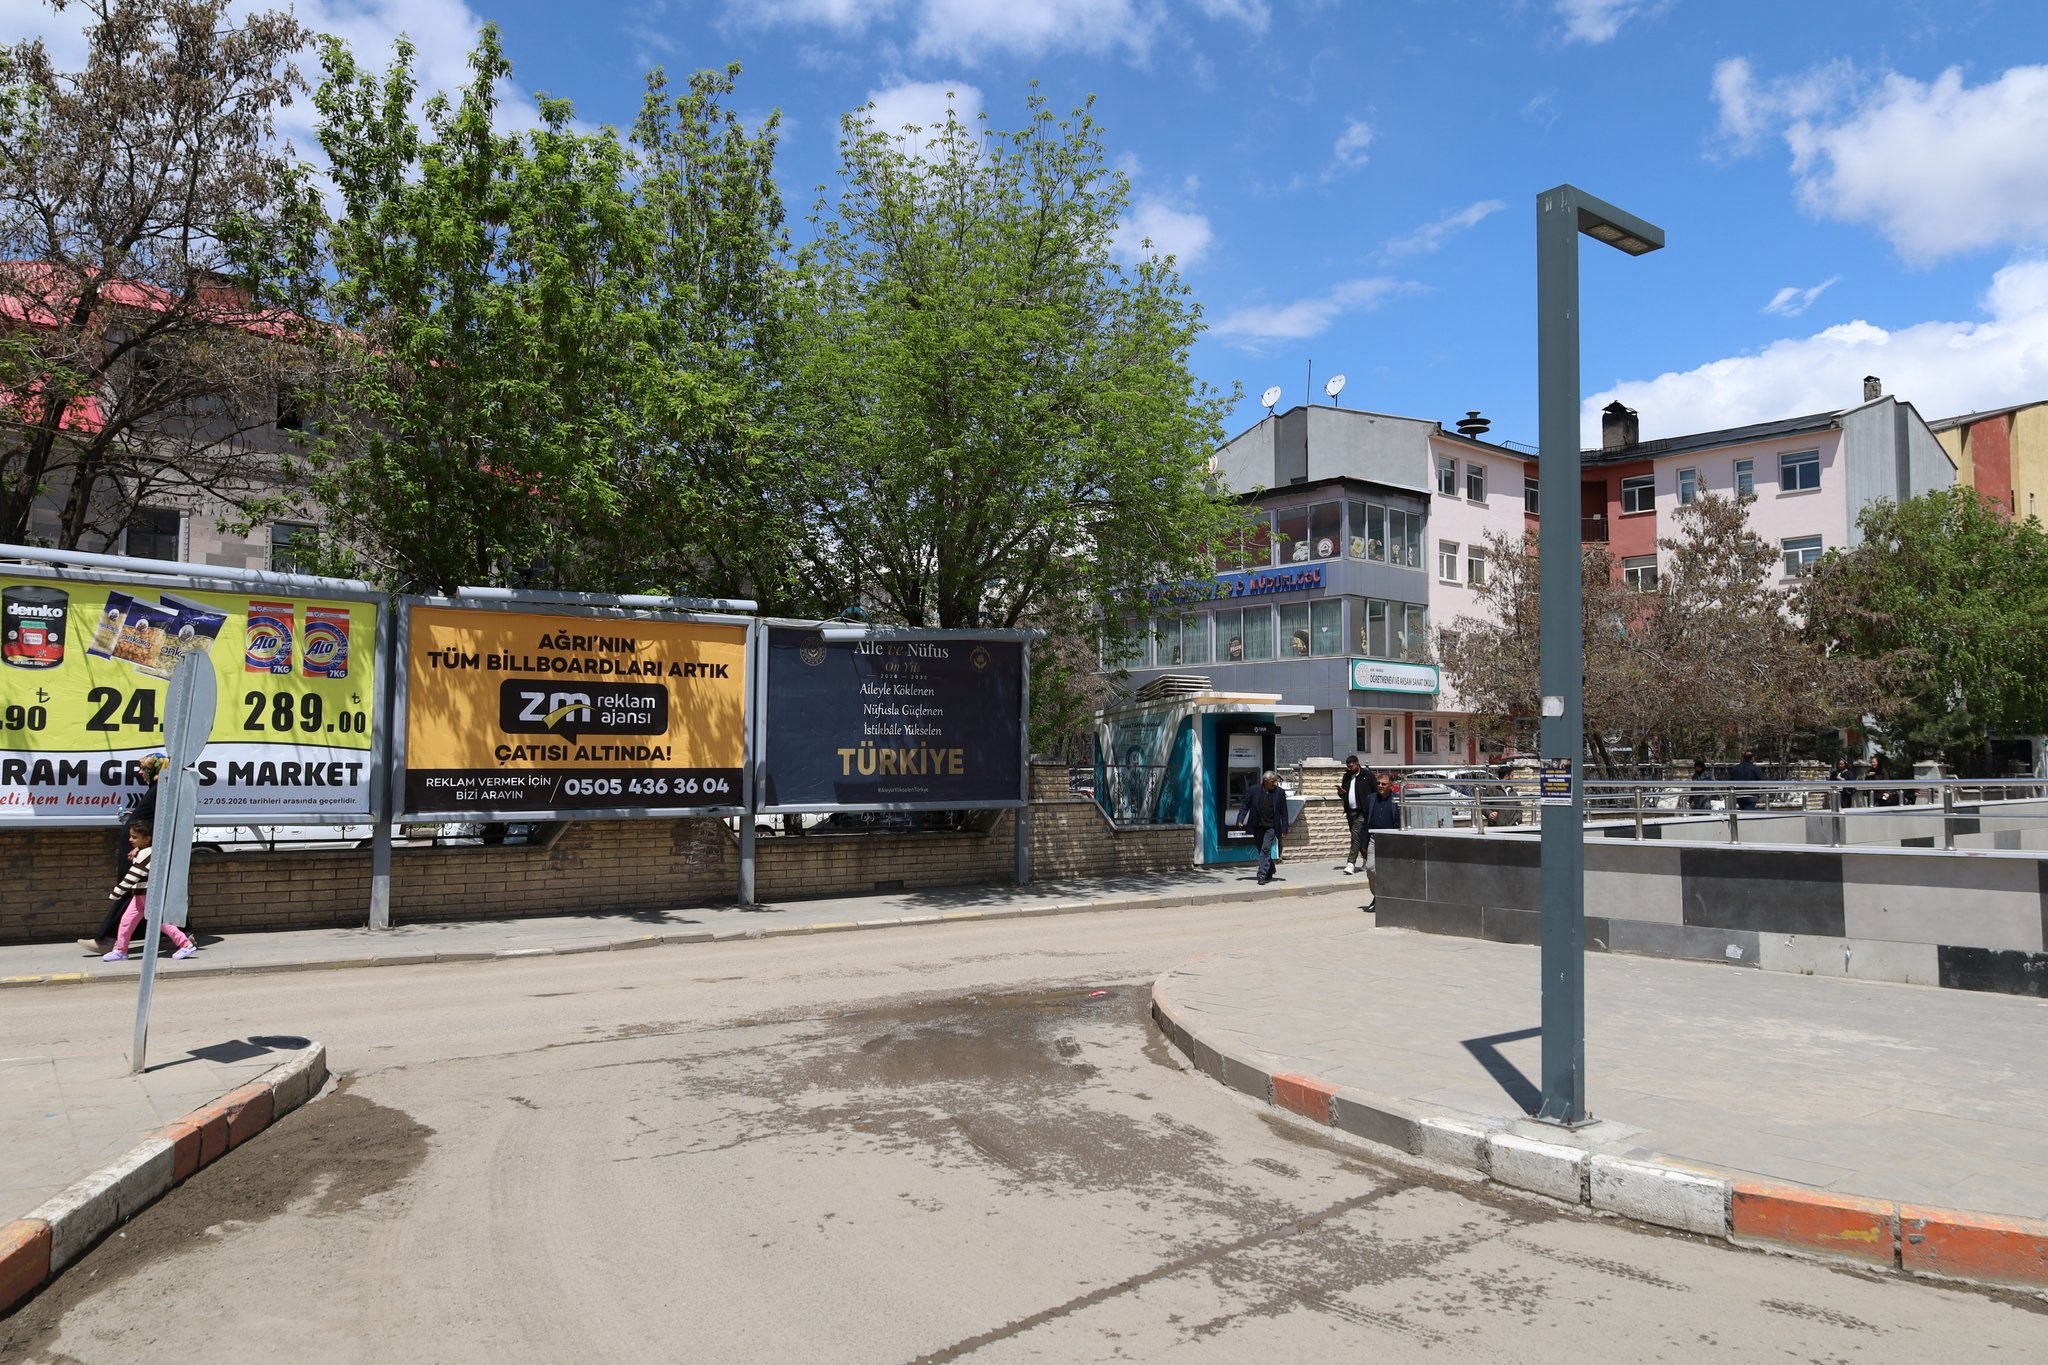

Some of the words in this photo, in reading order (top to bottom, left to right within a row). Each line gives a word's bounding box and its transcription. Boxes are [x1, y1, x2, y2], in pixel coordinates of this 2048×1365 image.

[7, 603, 63, 618] demko
[854, 640, 884, 655] Aile
[907, 643, 949, 659] Nüfus
[272, 665, 290, 674] 7KG
[427, 647, 480, 671] TÜM
[487, 650, 662, 677] BİLLBOARDLARI
[668, 662, 729, 679] ARTIK
[329, 670, 346, 678] 7KG
[860, 682, 891, 698] Aileyle
[893, 683, 935, 697] Köklenen
[598, 695, 656, 709] reklam
[863, 702, 900, 718] Nüfusla
[902, 704, 943, 719] Güçlenen
[243, 691, 366, 733] 289.00
[601, 709, 651, 727] ajansı
[904, 724, 942, 736] Yükselen
[495, 745, 568, 765] ÇATISI
[575, 746, 672, 762] ALTINDA!
[837, 740, 964, 776] TÜRKİYE
[228, 761, 363, 787] MARKET
[426, 778, 475, 787] REKLAM
[478, 777, 525, 787] VERMEK
[528, 775, 551, 788] İÇİN
[456, 789, 478, 800] BİZİ
[481, 790, 523, 800] ARAYIN
[564, 779, 622, 796] 0505
[628, 778, 668, 795] 436
[674, 778, 698, 794] 36
[703, 778, 729, 794] 04
[66, 791, 122, 808] hesaplı
[250, 797, 281, 805] tarihleri
[283, 797, 317, 805] arasında
